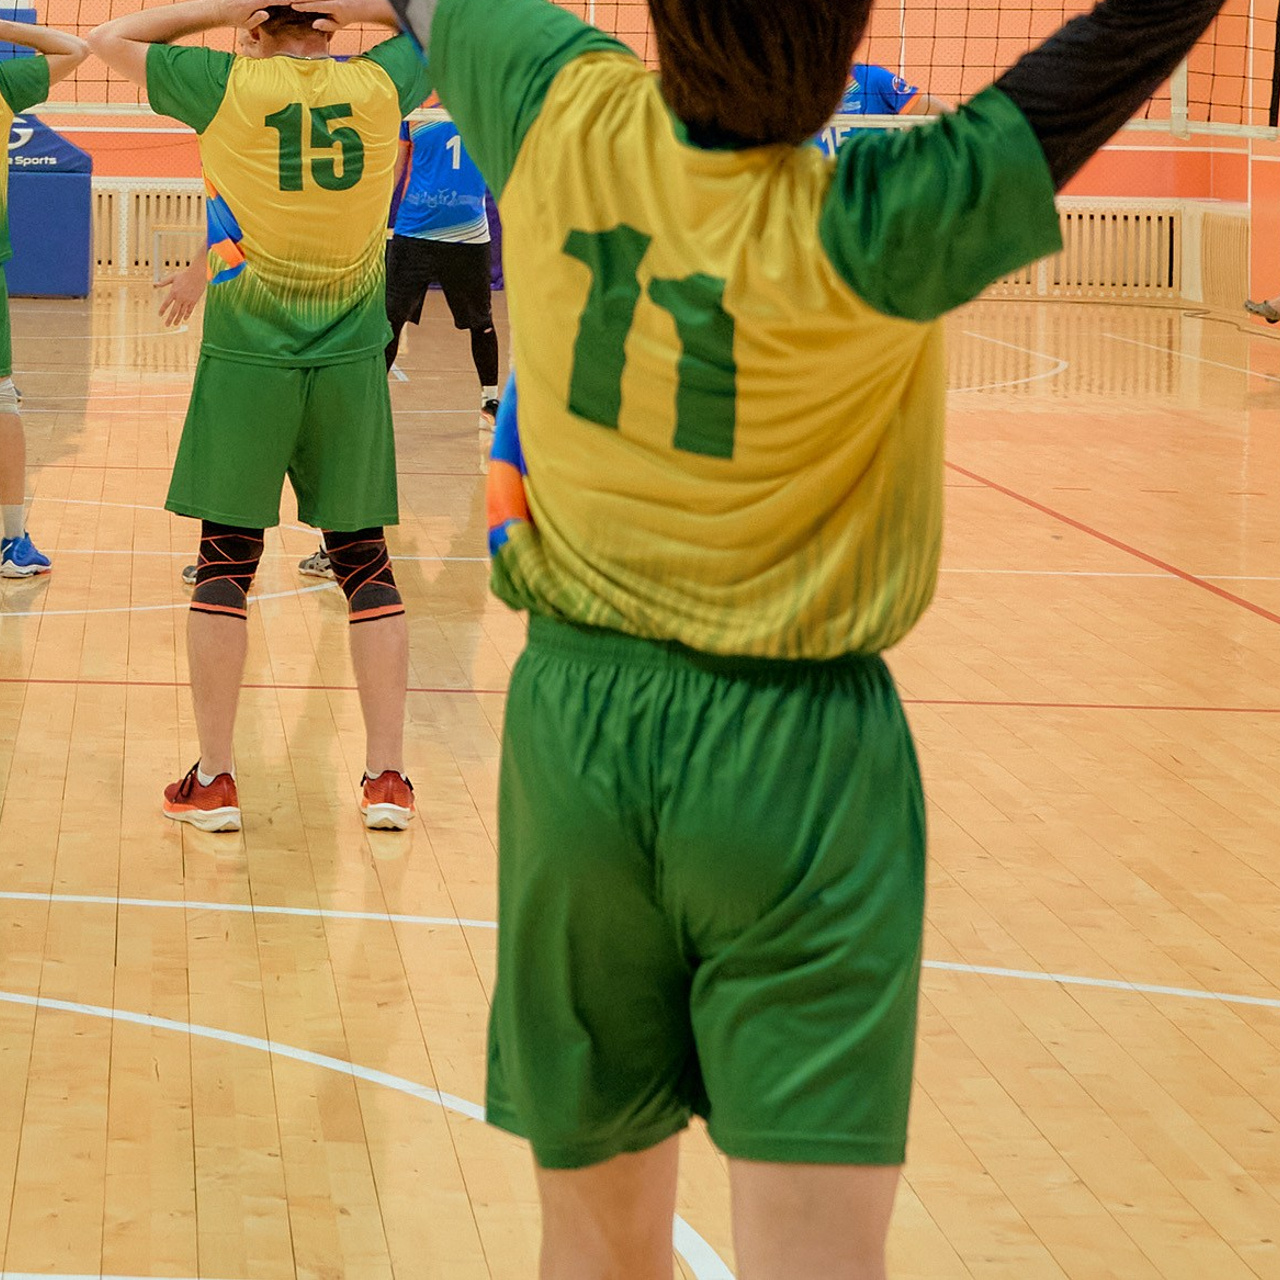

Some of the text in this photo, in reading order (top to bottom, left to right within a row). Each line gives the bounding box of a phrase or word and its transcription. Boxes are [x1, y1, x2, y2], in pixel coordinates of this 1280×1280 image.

[14, 156, 58, 167] Sports
[265, 102, 365, 191] 15
[445, 134, 461, 170] 1
[561, 222, 737, 461] 11
